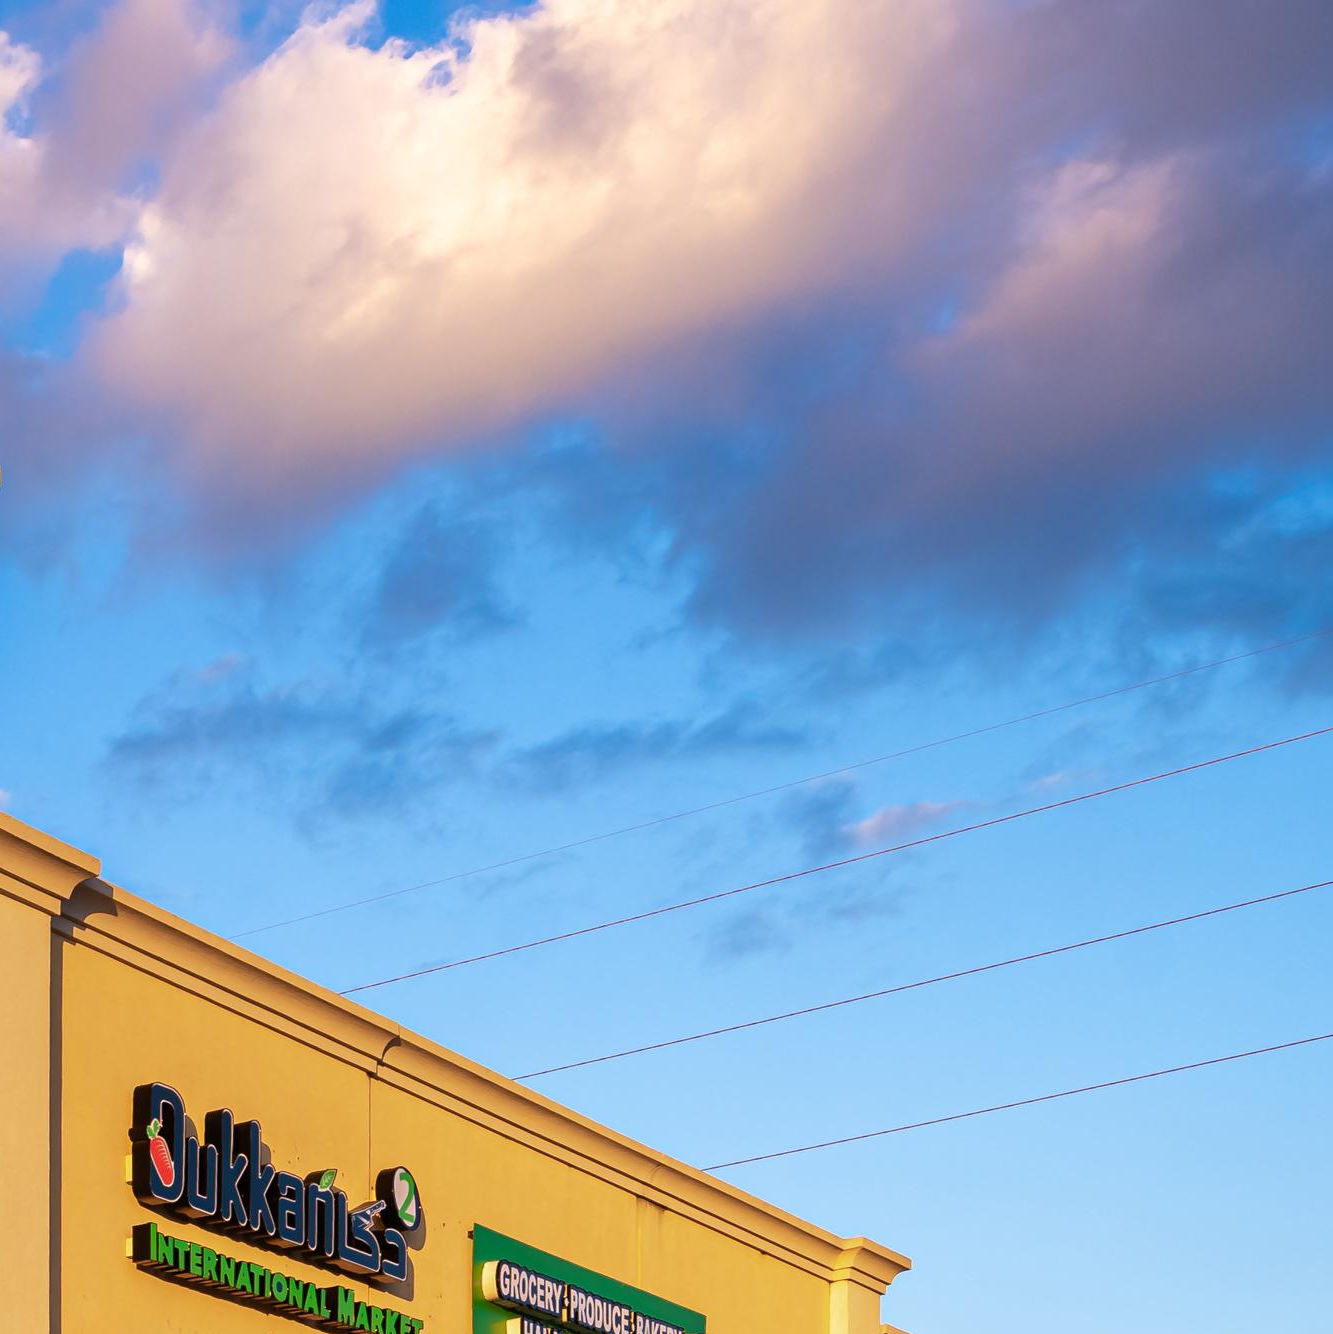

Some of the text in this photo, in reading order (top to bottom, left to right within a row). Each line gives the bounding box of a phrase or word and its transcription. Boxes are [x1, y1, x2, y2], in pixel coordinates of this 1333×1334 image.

[147, 1082, 335, 1257] Dukkan
[149, 1222, 331, 1320] INTERNATIONAL
[498, 1262, 563, 1315] GROCERY
